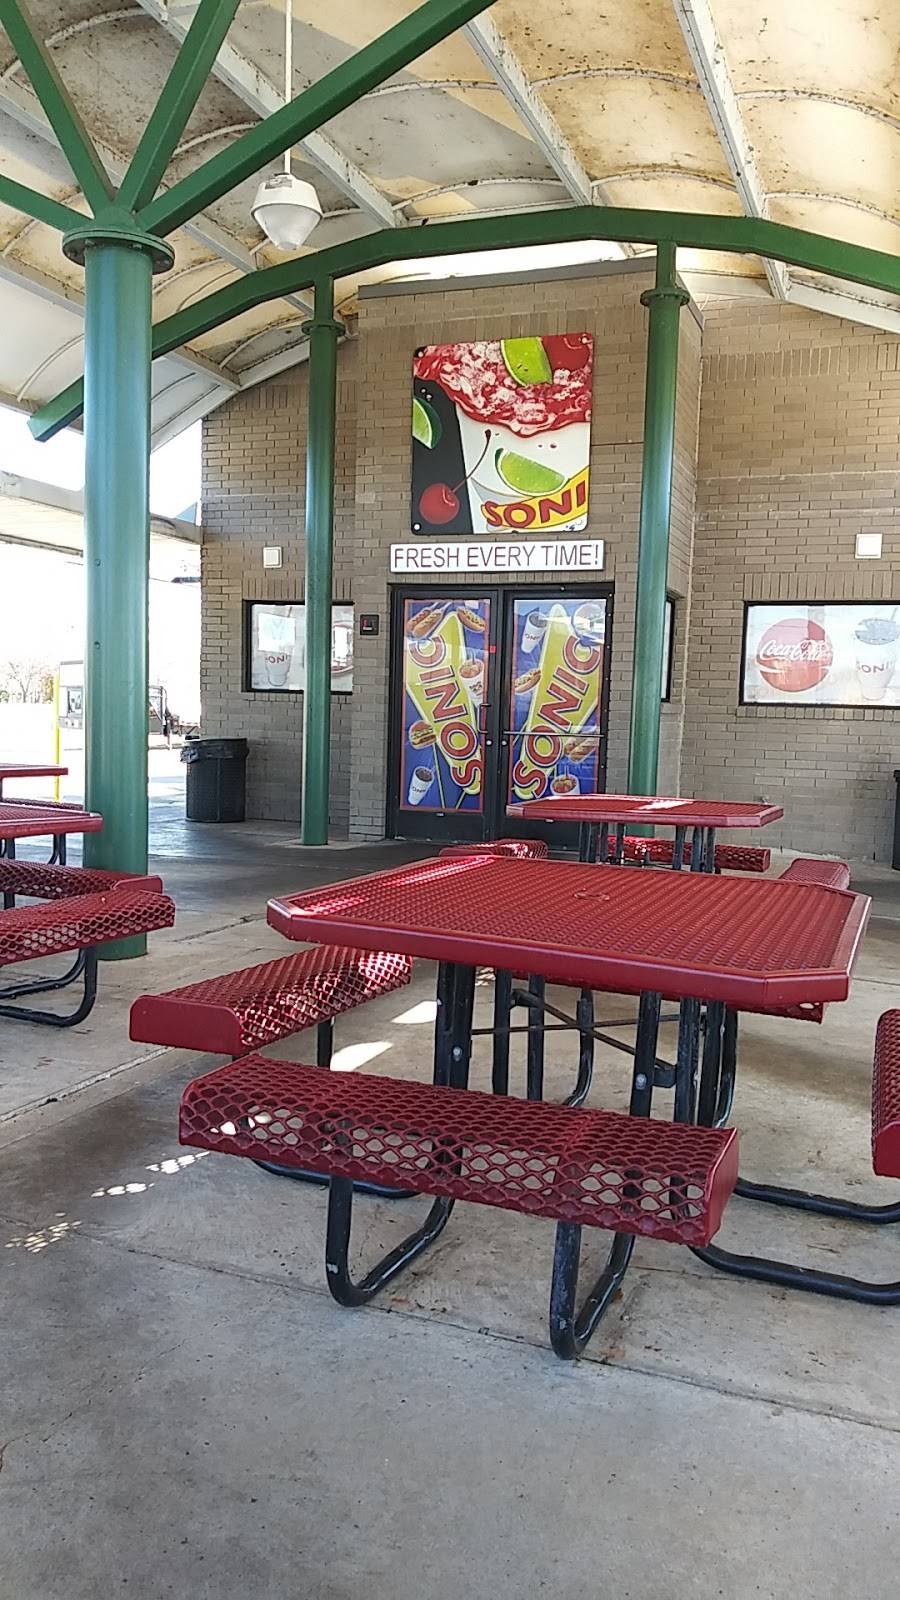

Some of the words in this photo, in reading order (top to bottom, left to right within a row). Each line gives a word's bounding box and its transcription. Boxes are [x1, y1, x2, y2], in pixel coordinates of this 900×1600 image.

[484, 484, 585, 528] SONI
[394, 547, 459, 568] FRESH
[466, 545, 536, 567] EVERY
[540, 544, 599, 566] TIME!
[408, 634, 482, 787] SONIC
[513, 634, 601, 799] SONIC
